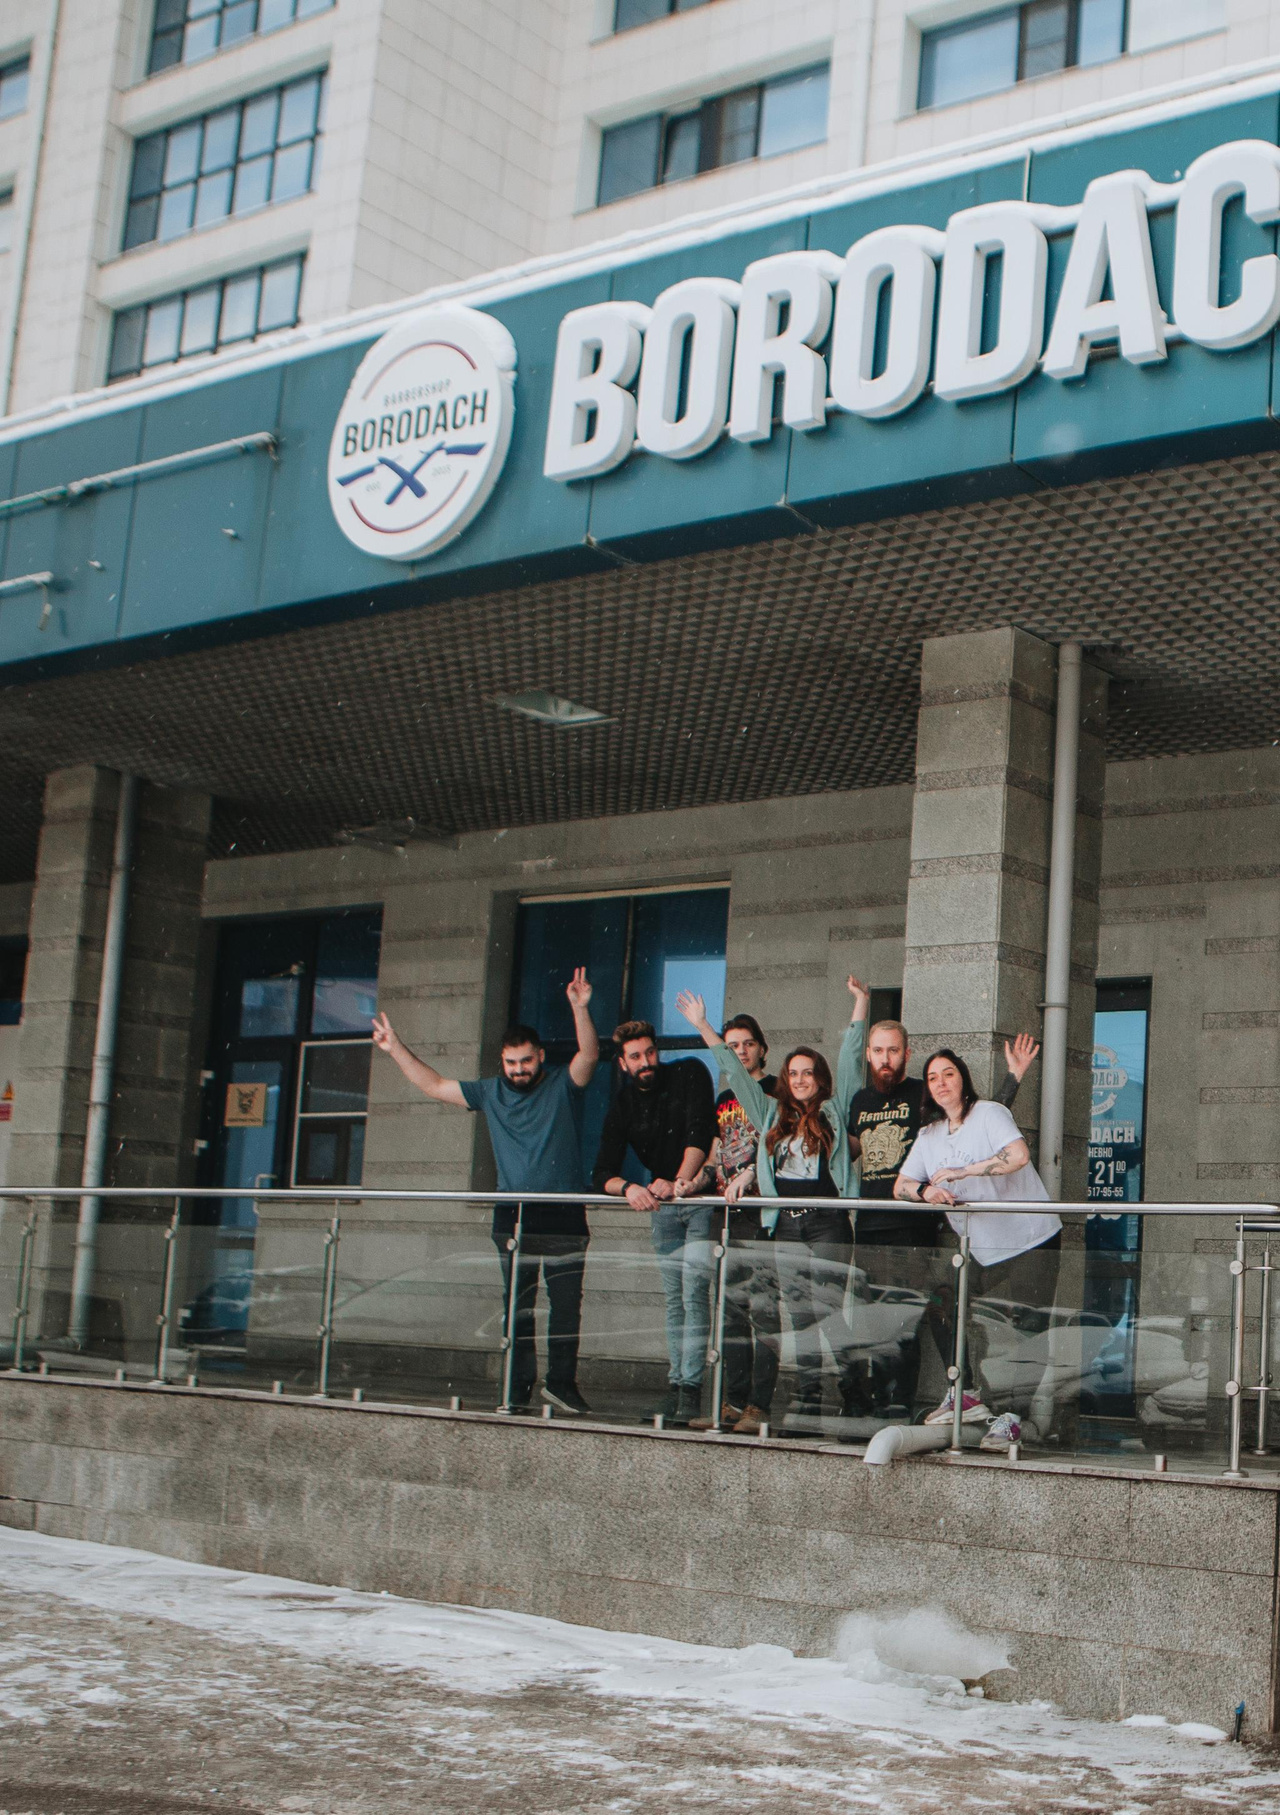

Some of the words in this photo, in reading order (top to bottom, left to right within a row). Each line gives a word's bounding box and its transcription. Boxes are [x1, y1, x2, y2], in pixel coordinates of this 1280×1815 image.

[343, 388, 489, 457] BORODACH
[1091, 1071, 1120, 1086] DACH
[1089, 1127, 1136, 1143] DACH
[1087, 1146, 1113, 1158] НЕВНО
[1087, 1186, 1124, 1197] 517-95-55
